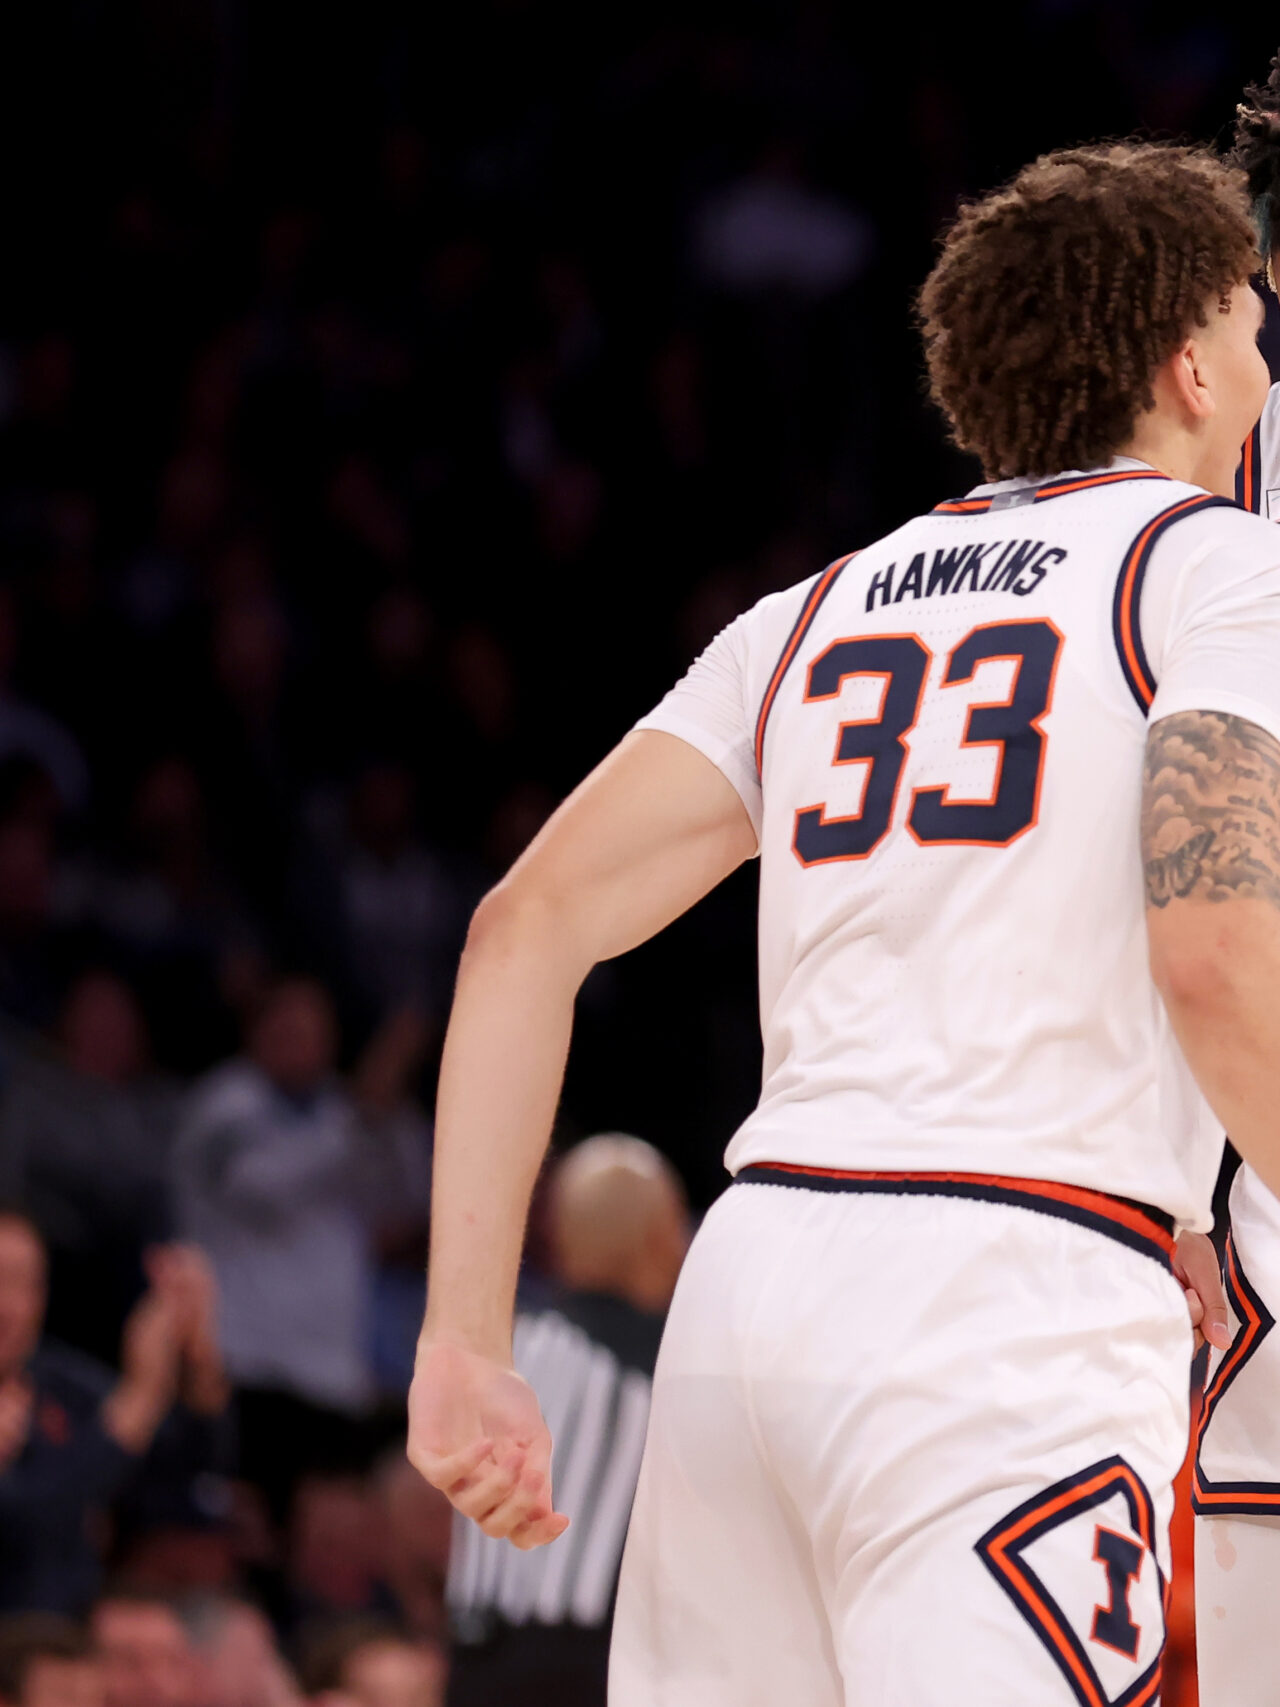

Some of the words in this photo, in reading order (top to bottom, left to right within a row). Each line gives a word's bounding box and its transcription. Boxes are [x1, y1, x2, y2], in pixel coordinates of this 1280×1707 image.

[865, 539, 1068, 613] HAWKINS
[791, 618, 1065, 868] 33
[1089, 1523, 1145, 1663] I
